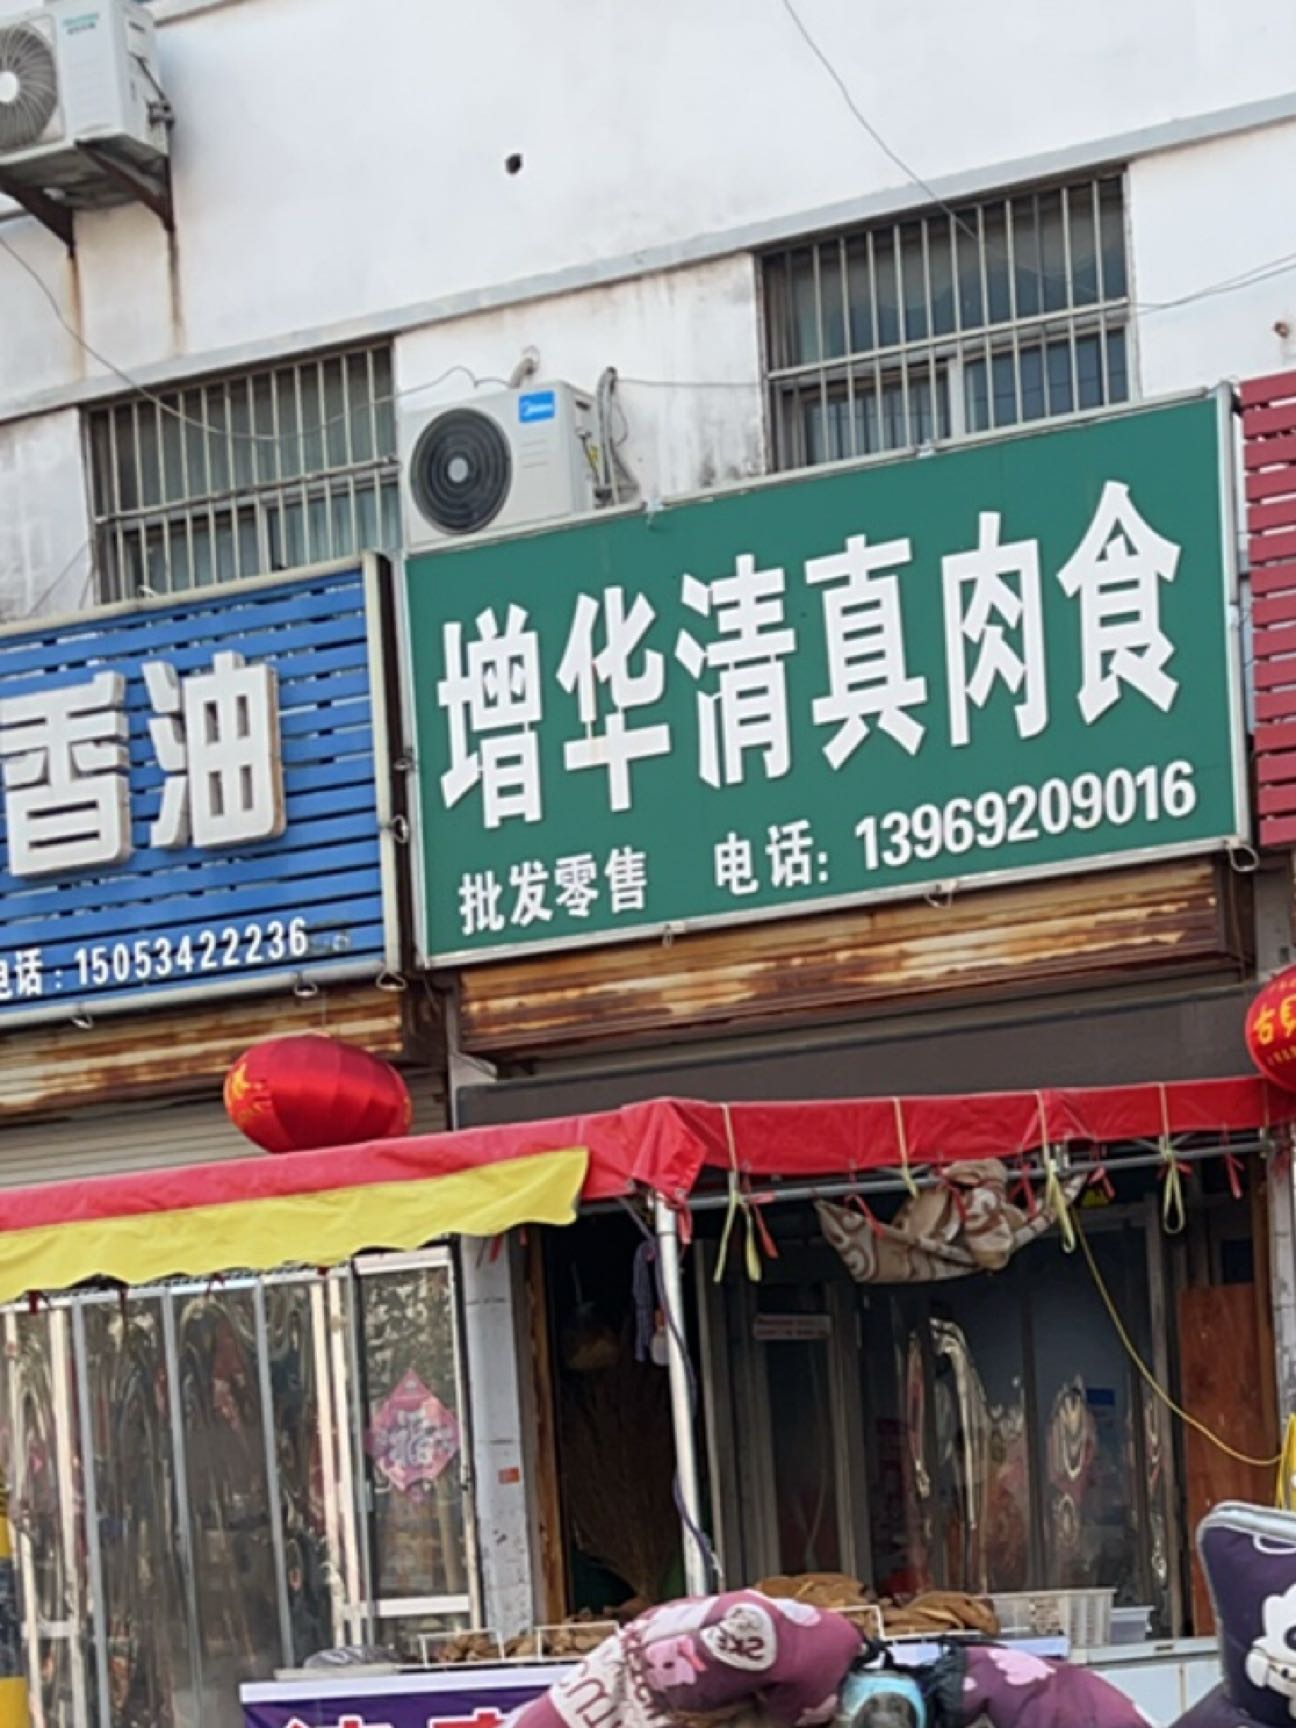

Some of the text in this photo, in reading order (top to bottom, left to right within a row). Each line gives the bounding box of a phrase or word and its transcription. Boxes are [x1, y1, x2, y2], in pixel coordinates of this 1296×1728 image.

[0, 650, 286, 878] 香油
[437, 479, 1182, 829] 增华清真肉食
[458, 847, 650, 935] 批发零售
[855, 760, 1197, 871] 13969209016
